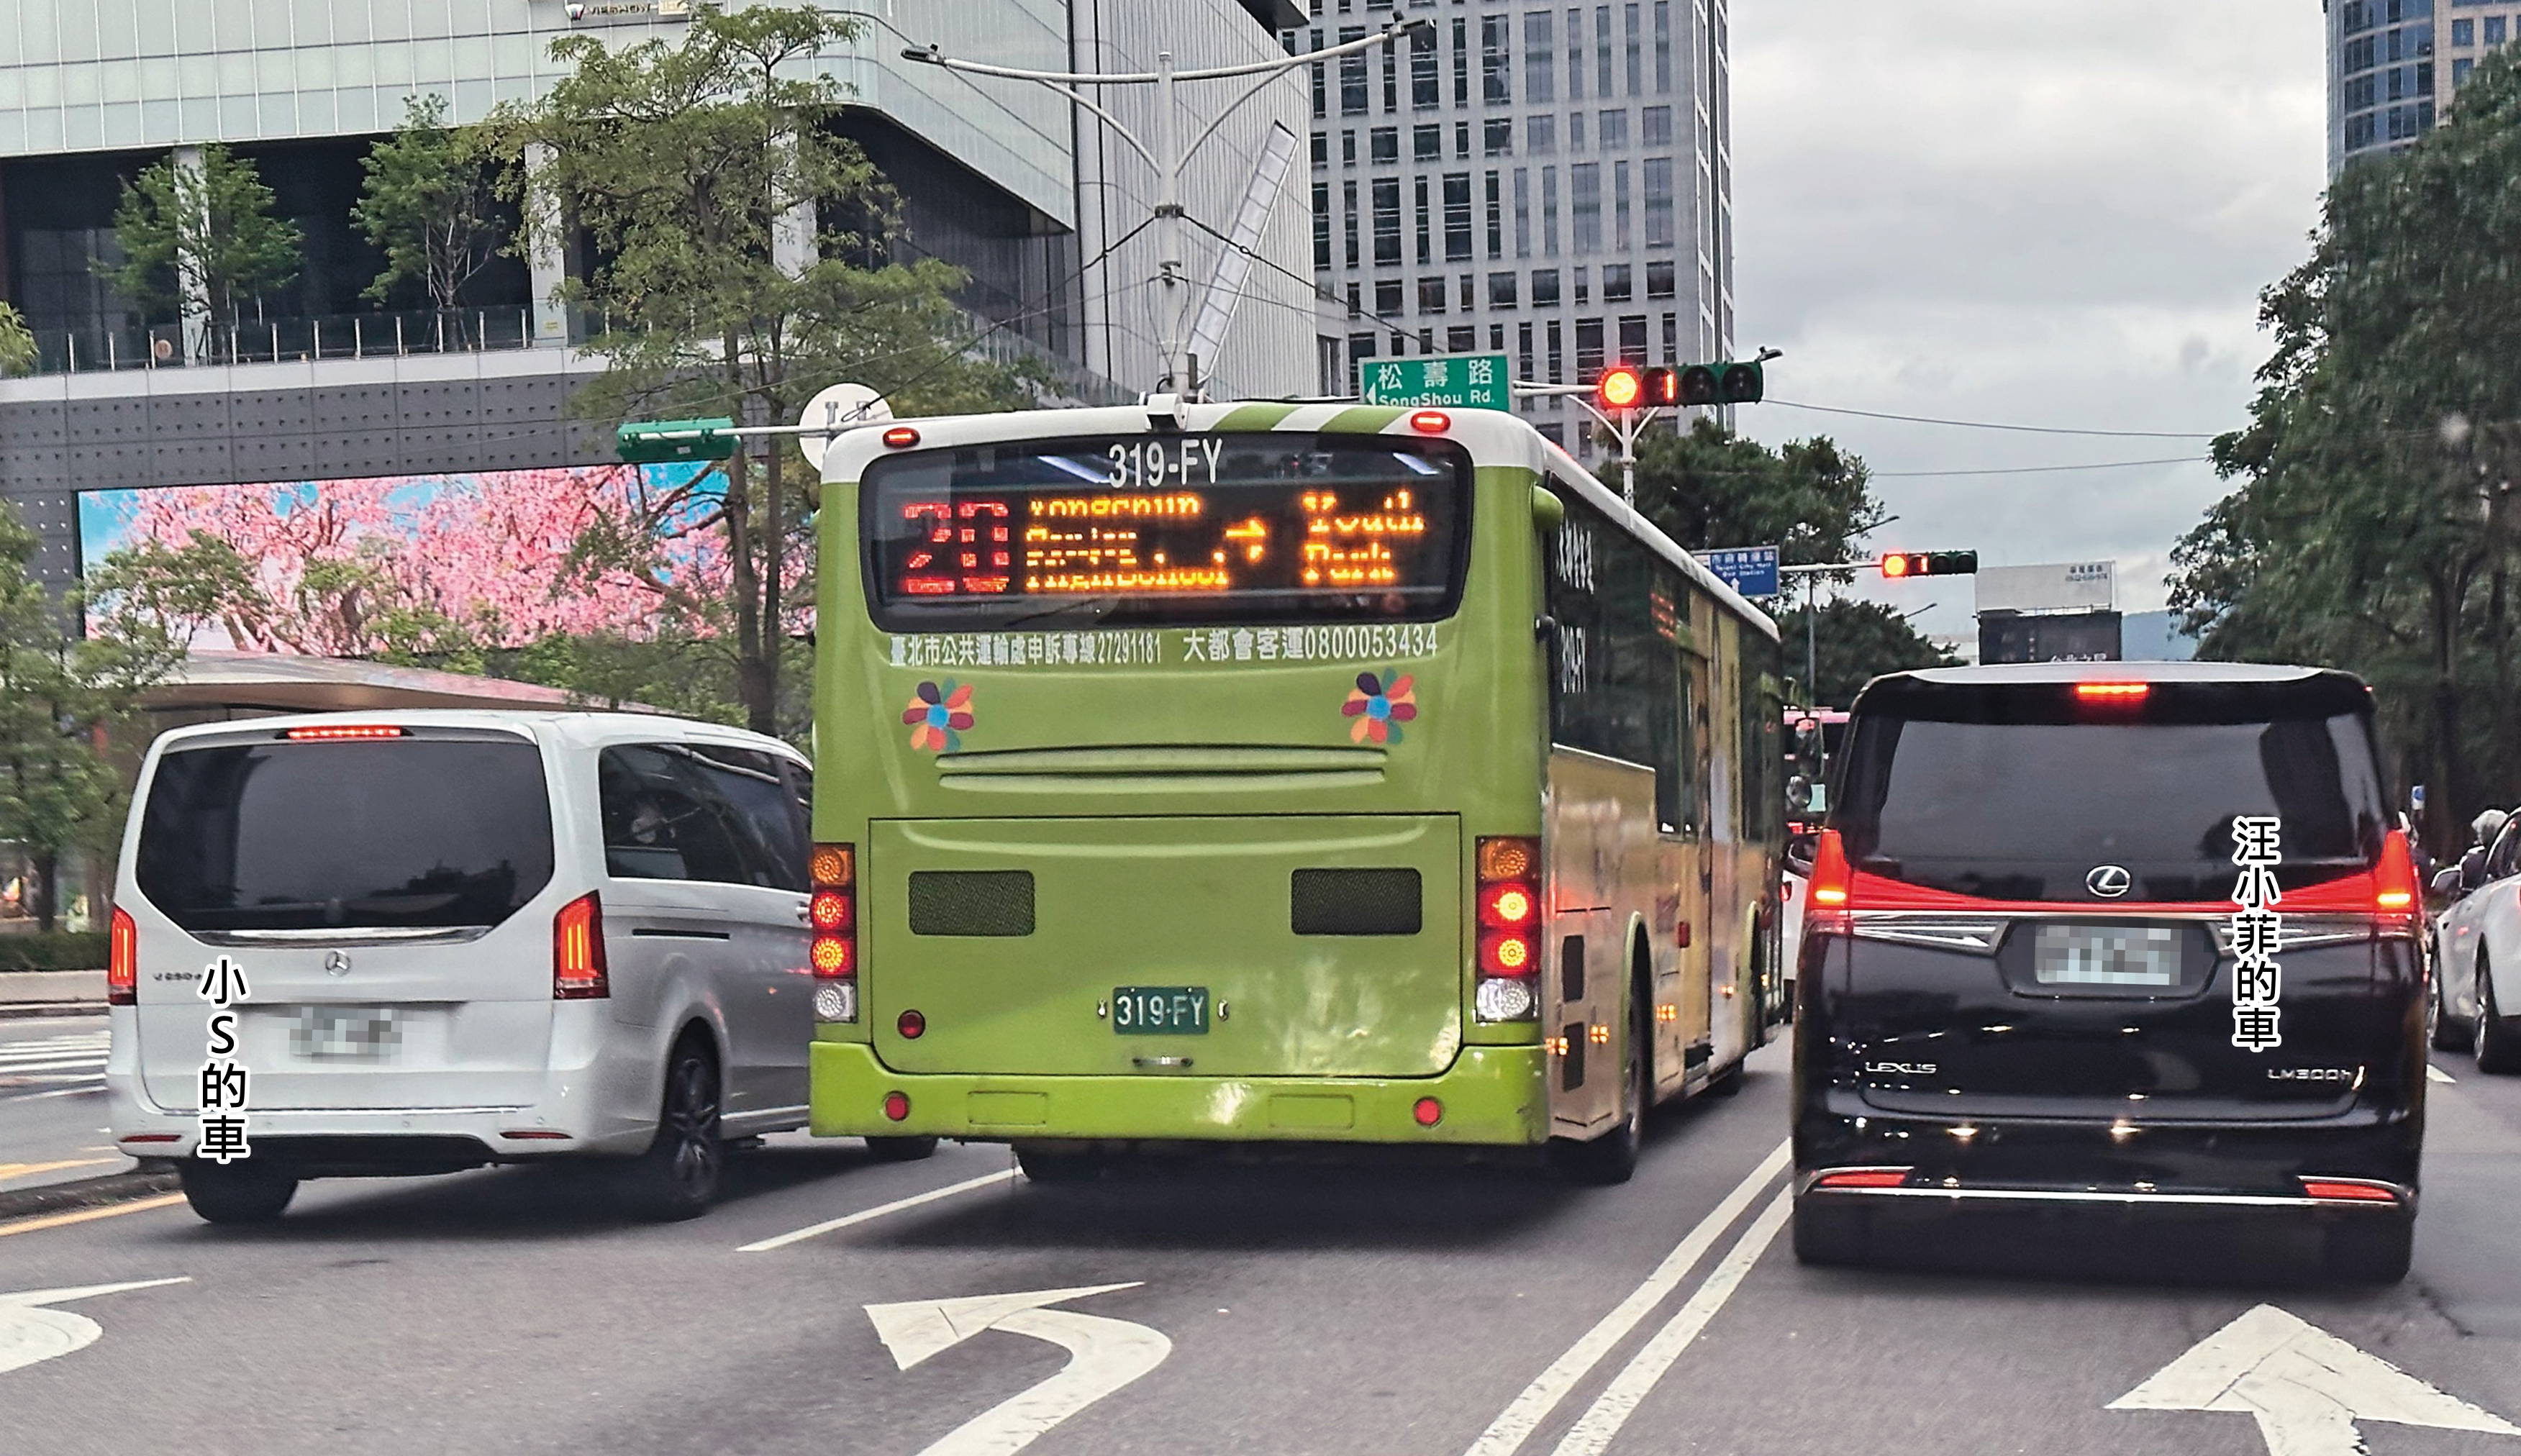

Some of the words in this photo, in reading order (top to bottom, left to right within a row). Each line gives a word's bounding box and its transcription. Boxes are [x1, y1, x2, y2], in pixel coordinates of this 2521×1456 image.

[1378, 358, 1492, 390] 松壽路
[1378, 392, 1462, 406] SongShou
[1470, 389, 1494, 404] Rd.
[1109, 437, 1222, 488] 319-FY
[1183, 624, 1438, 662] 大都會客運0800053434
[1865, 1062, 1937, 1074] LEXUS
